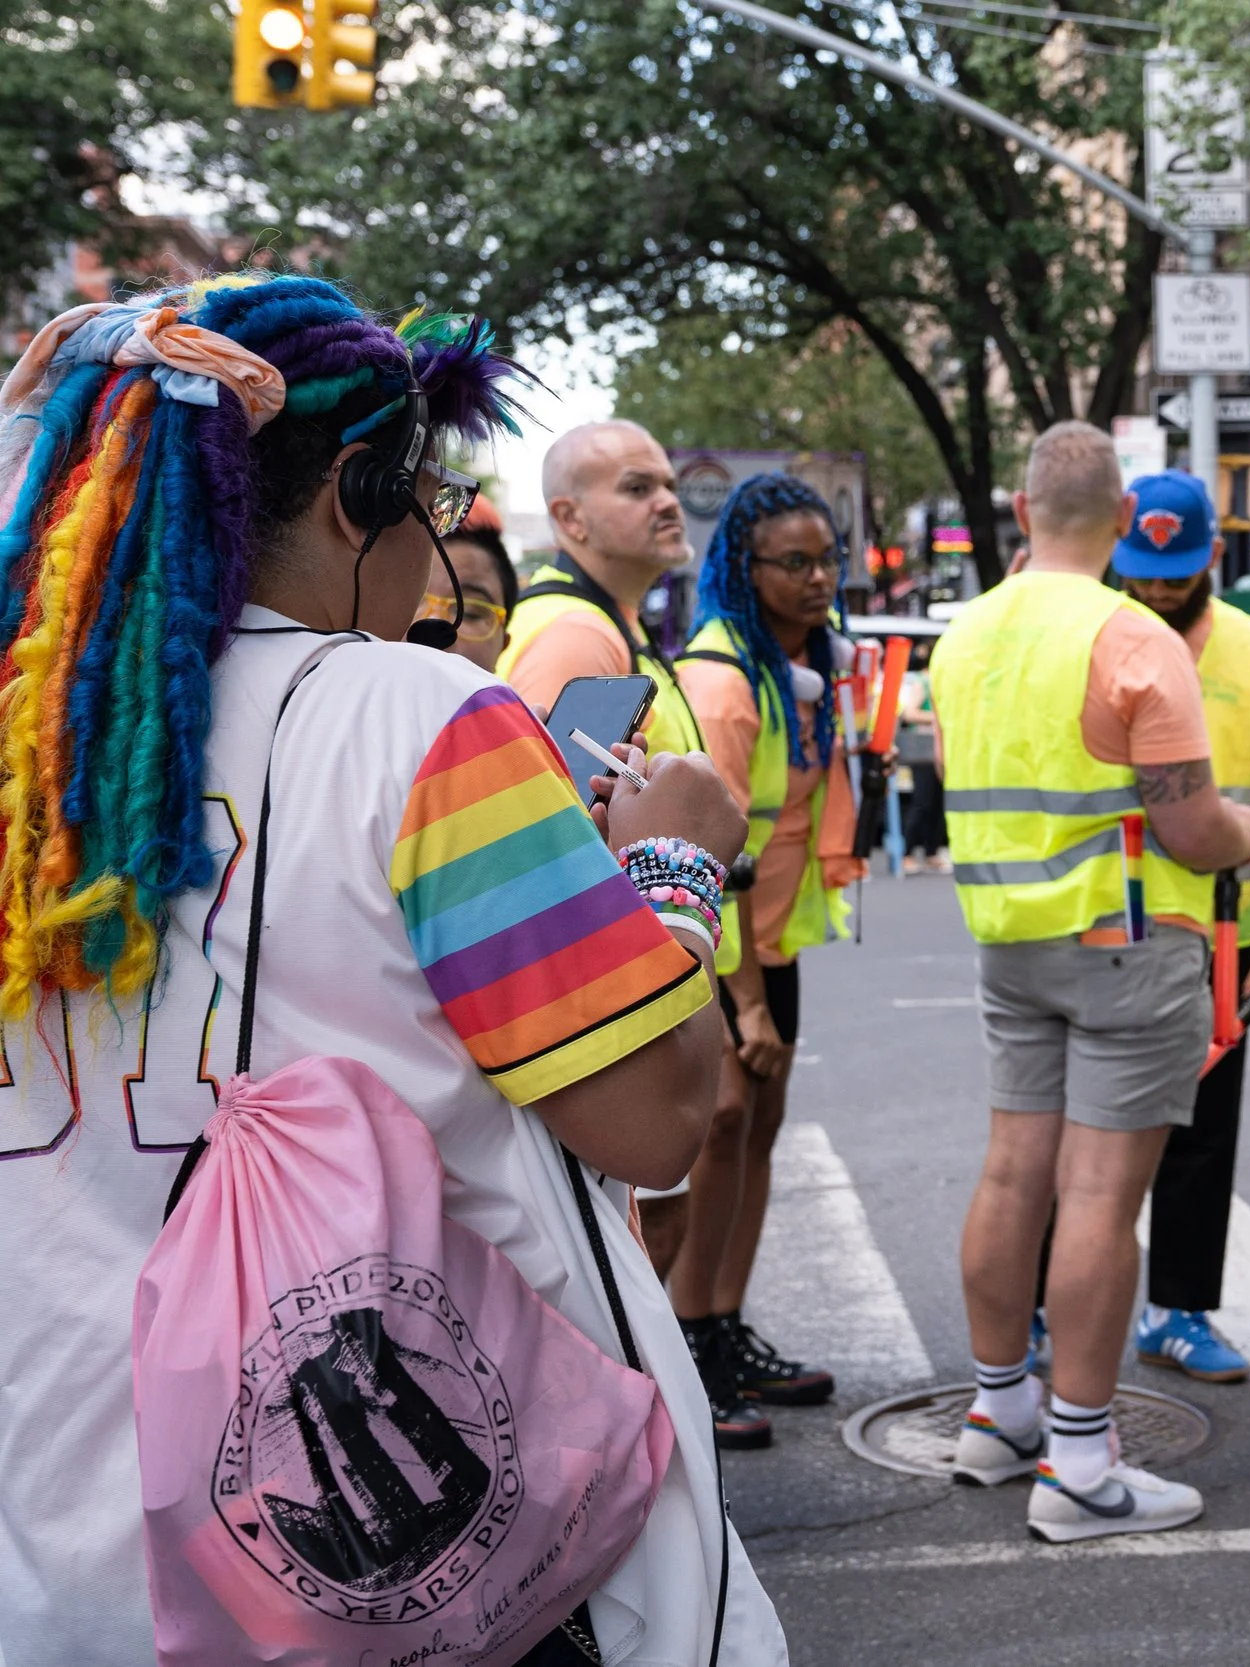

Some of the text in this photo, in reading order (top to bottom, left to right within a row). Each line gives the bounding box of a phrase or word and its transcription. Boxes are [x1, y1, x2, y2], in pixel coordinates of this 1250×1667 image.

[681, 866, 705, 881] YOU
[277, 1399, 520, 1620] 10 YEARS PROUD
[517, 1542, 562, 1596] means
